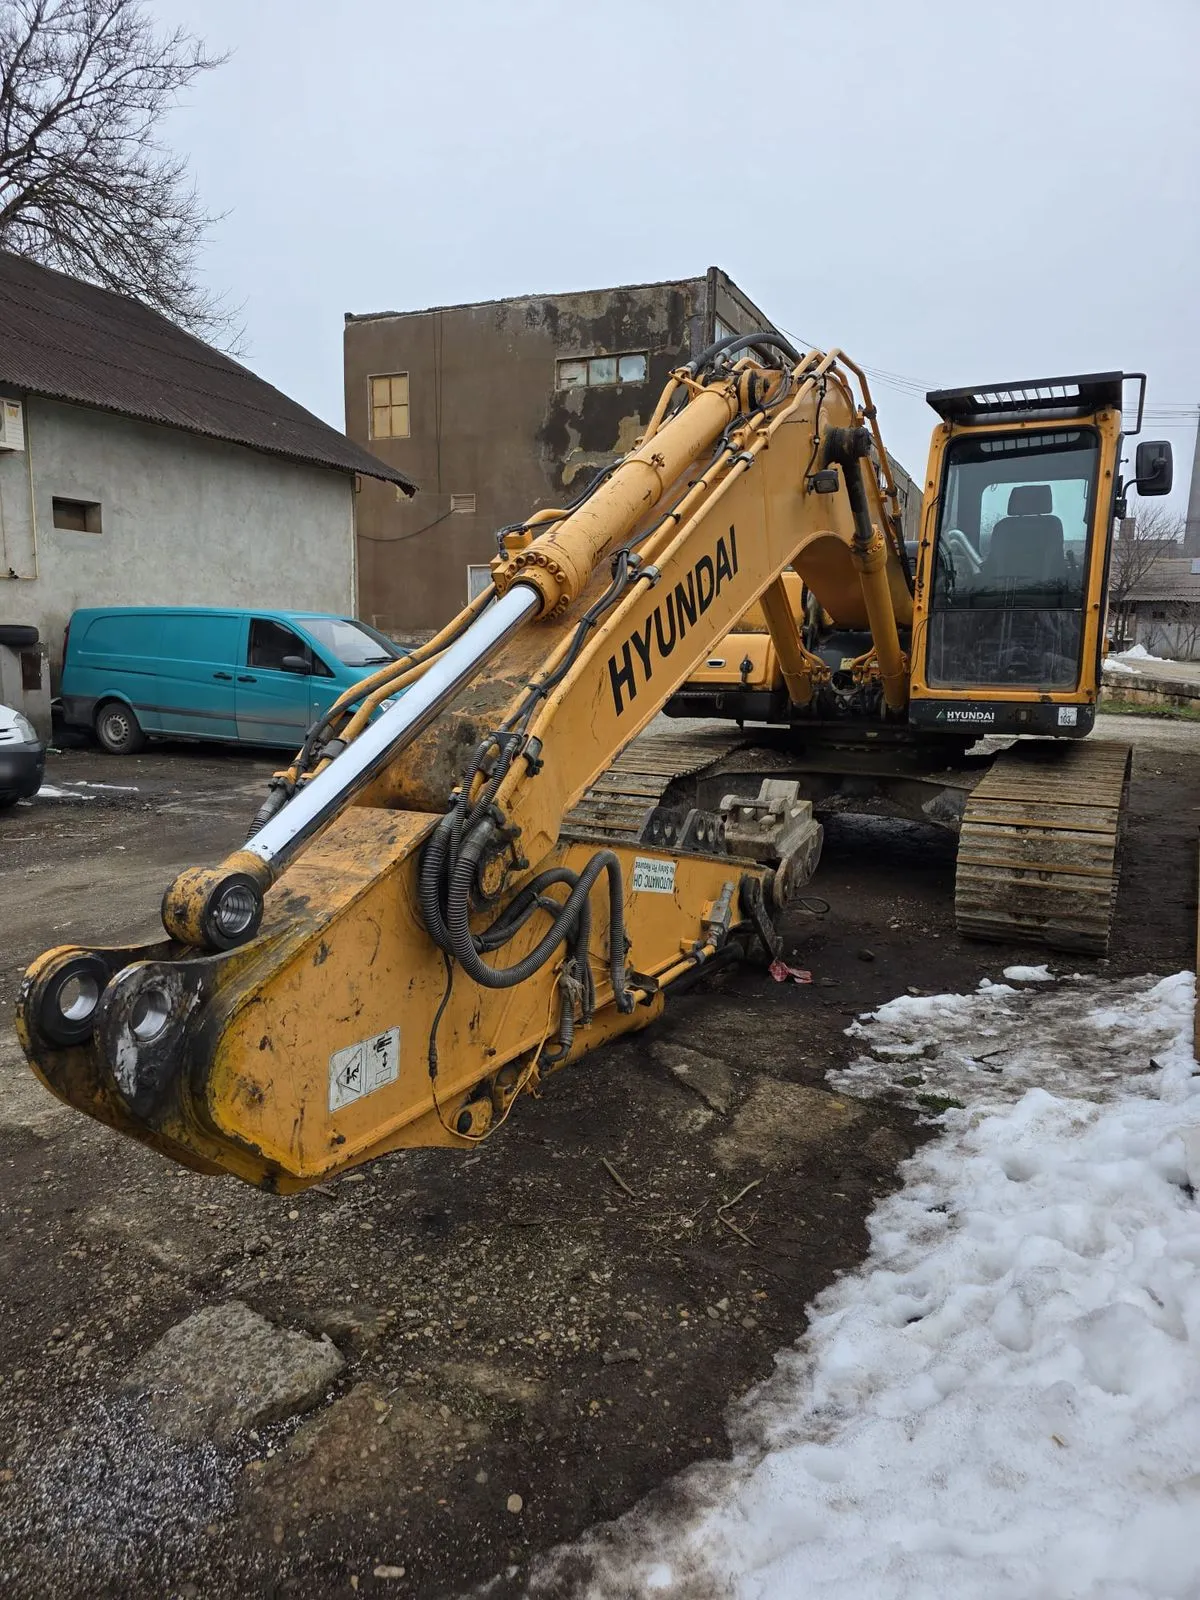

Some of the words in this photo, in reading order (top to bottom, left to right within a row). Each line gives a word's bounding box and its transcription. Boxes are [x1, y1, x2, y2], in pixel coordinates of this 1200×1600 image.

[608, 524, 738, 716] HYUNDAI
[947, 711, 995, 719] HYUNDAI
[644, 875, 673, 890] AUTOMATIC
